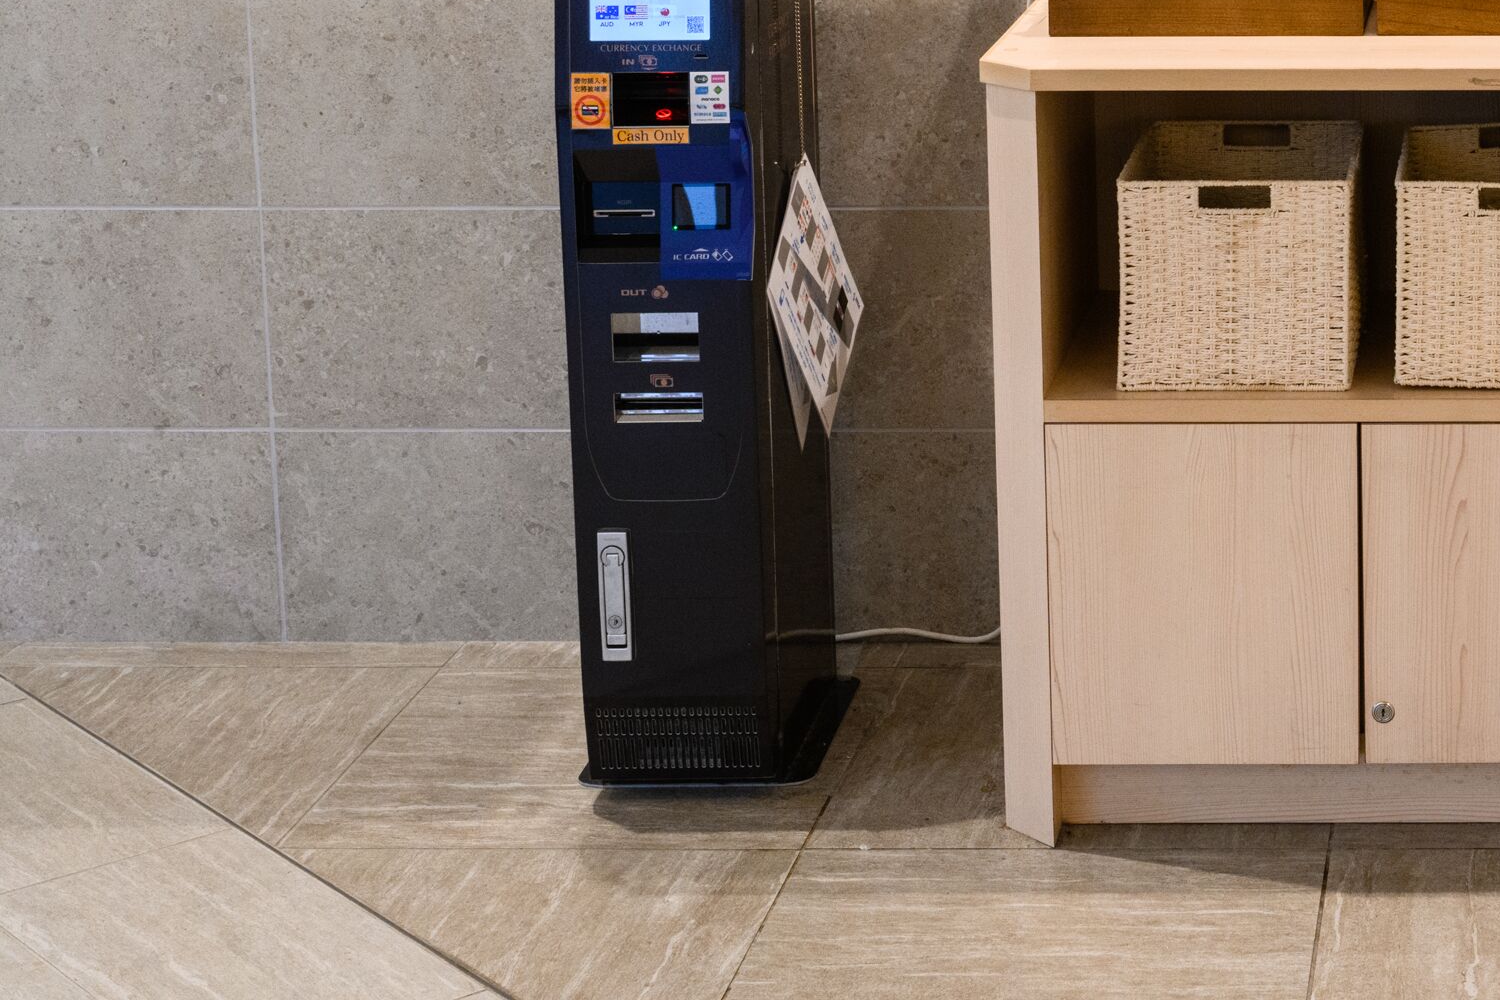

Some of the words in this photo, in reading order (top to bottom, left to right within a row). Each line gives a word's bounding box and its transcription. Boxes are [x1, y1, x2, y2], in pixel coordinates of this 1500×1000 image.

[600, 44, 649, 53] CURRENCY
[652, 44, 702, 52] EXCHANGE
[616, 130, 649, 142] Cash
[653, 130, 685, 143] Only
[683, 253, 710, 261] CARD
[620, 288, 647, 297] OUT
